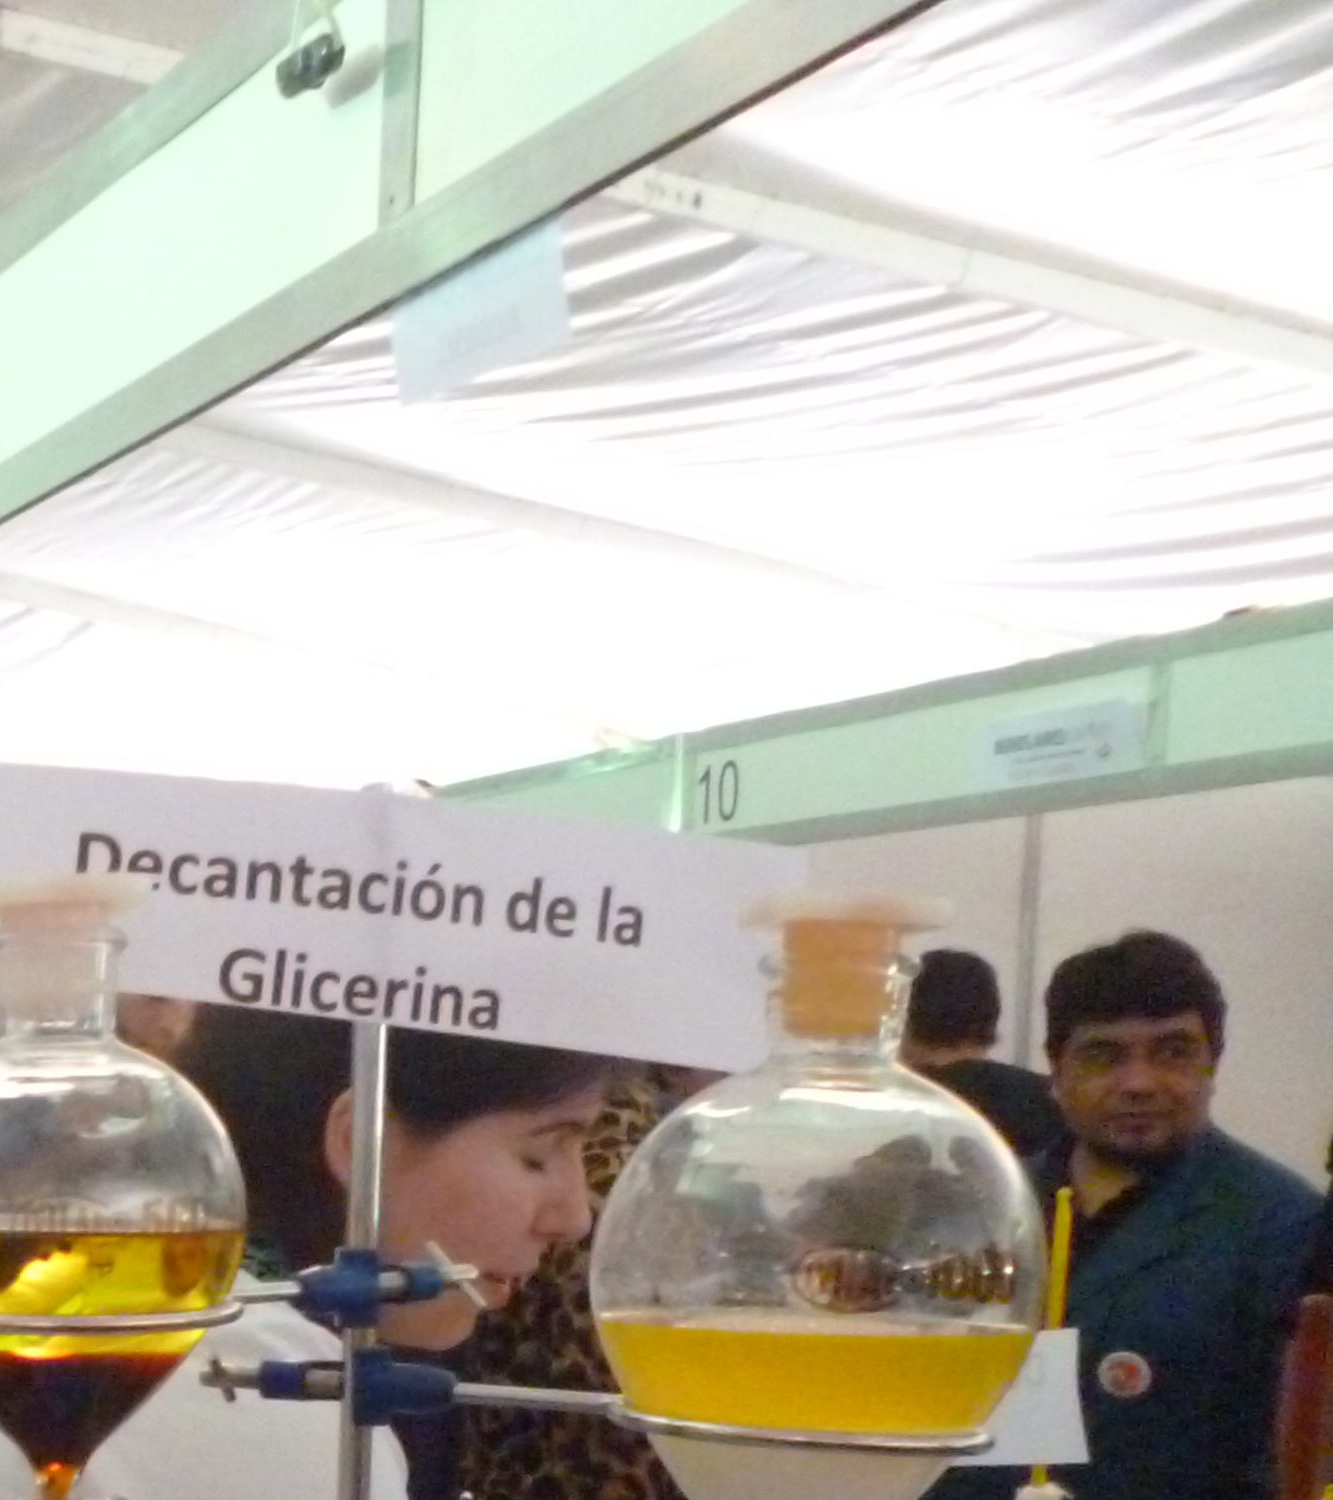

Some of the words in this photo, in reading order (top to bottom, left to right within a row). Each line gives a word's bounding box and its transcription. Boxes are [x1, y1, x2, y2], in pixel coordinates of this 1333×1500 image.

[697, 760, 739, 825] 10
[75, 831, 485, 928] Decantación
[504, 877, 578, 938] de
[596, 886, 646, 946] la
[218, 948, 502, 1032] Glicerina
